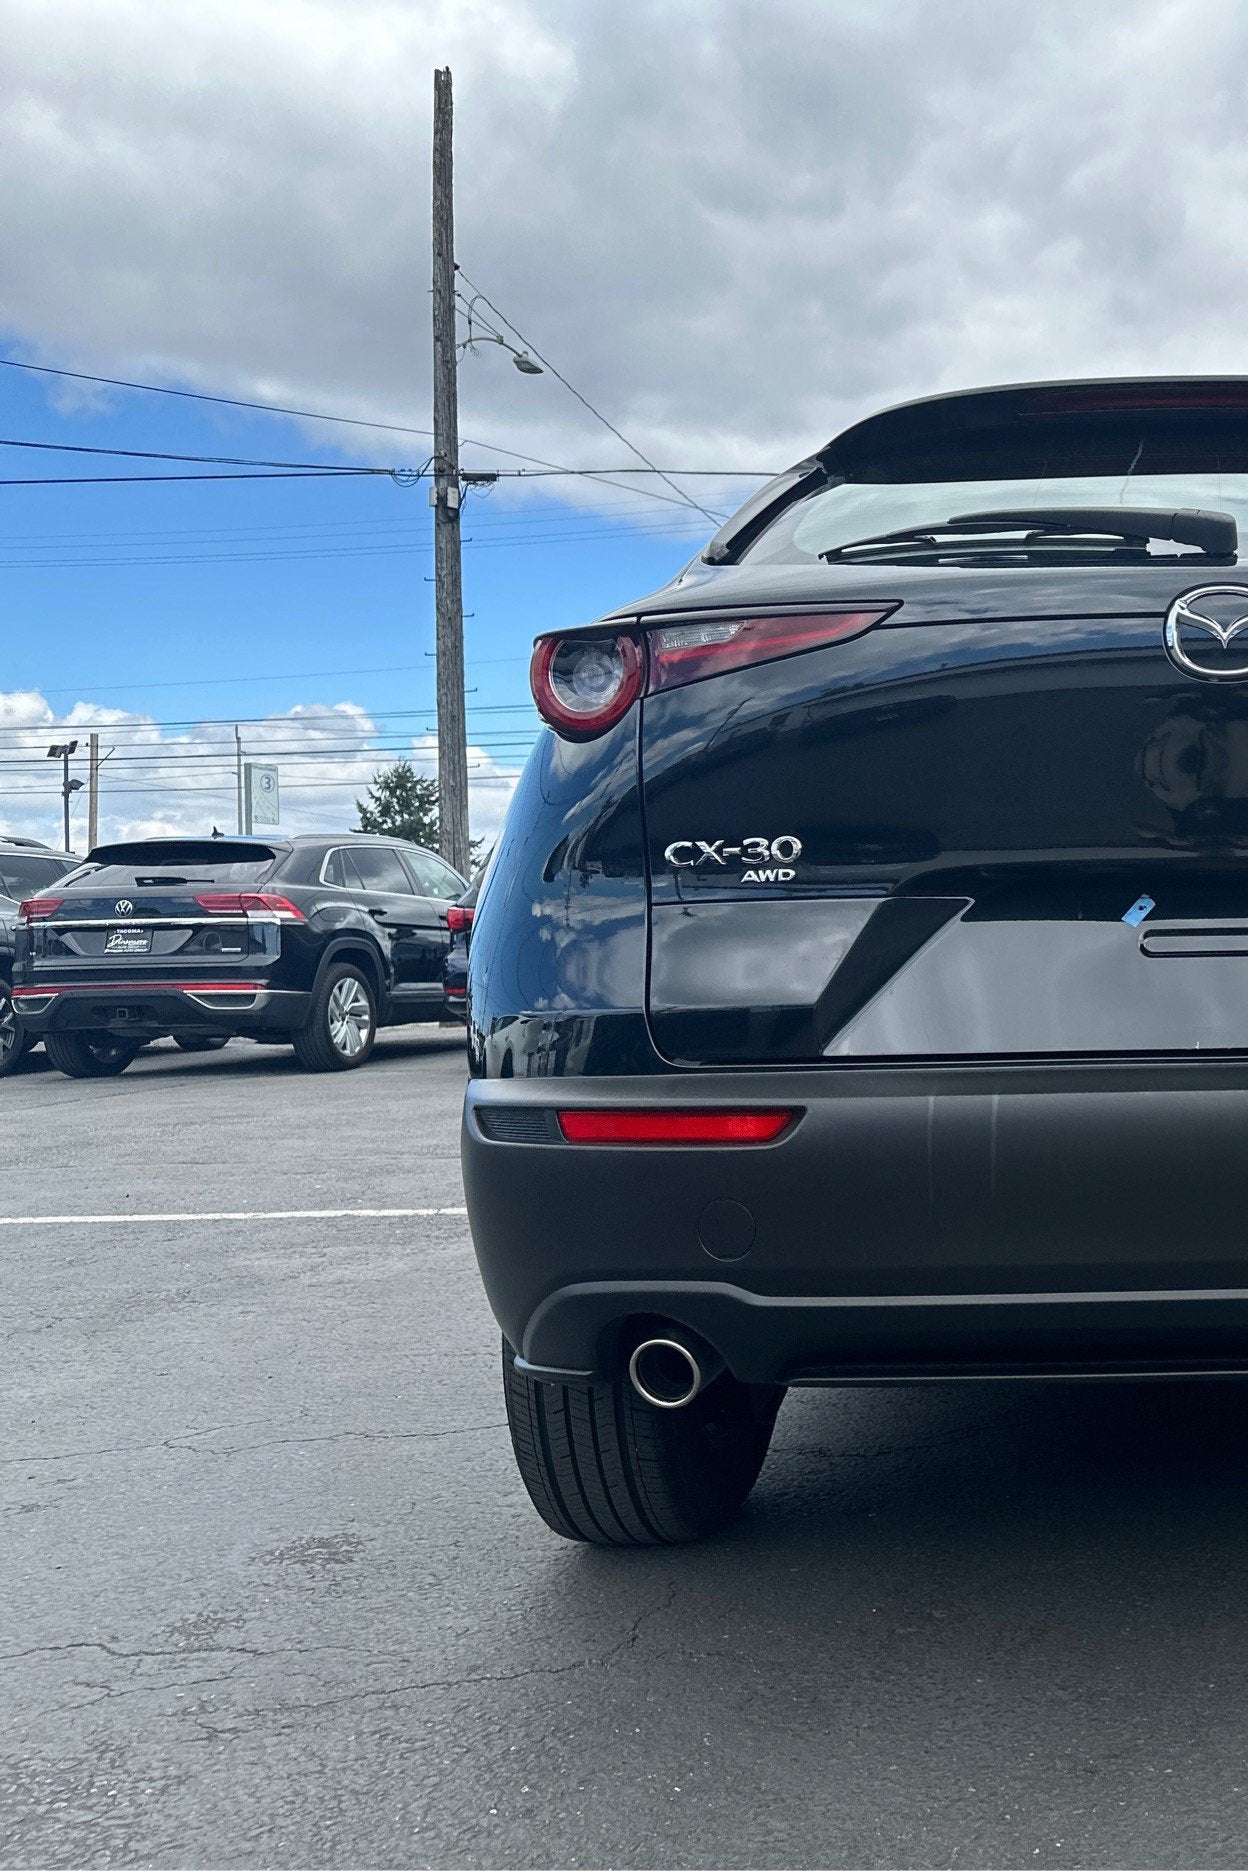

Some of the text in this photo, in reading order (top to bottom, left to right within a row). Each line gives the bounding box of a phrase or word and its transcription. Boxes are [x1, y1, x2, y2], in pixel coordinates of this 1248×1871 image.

[264, 776, 272, 790] 3
[664, 835, 802, 867] CX-30
[741, 868, 796, 882] AWD
